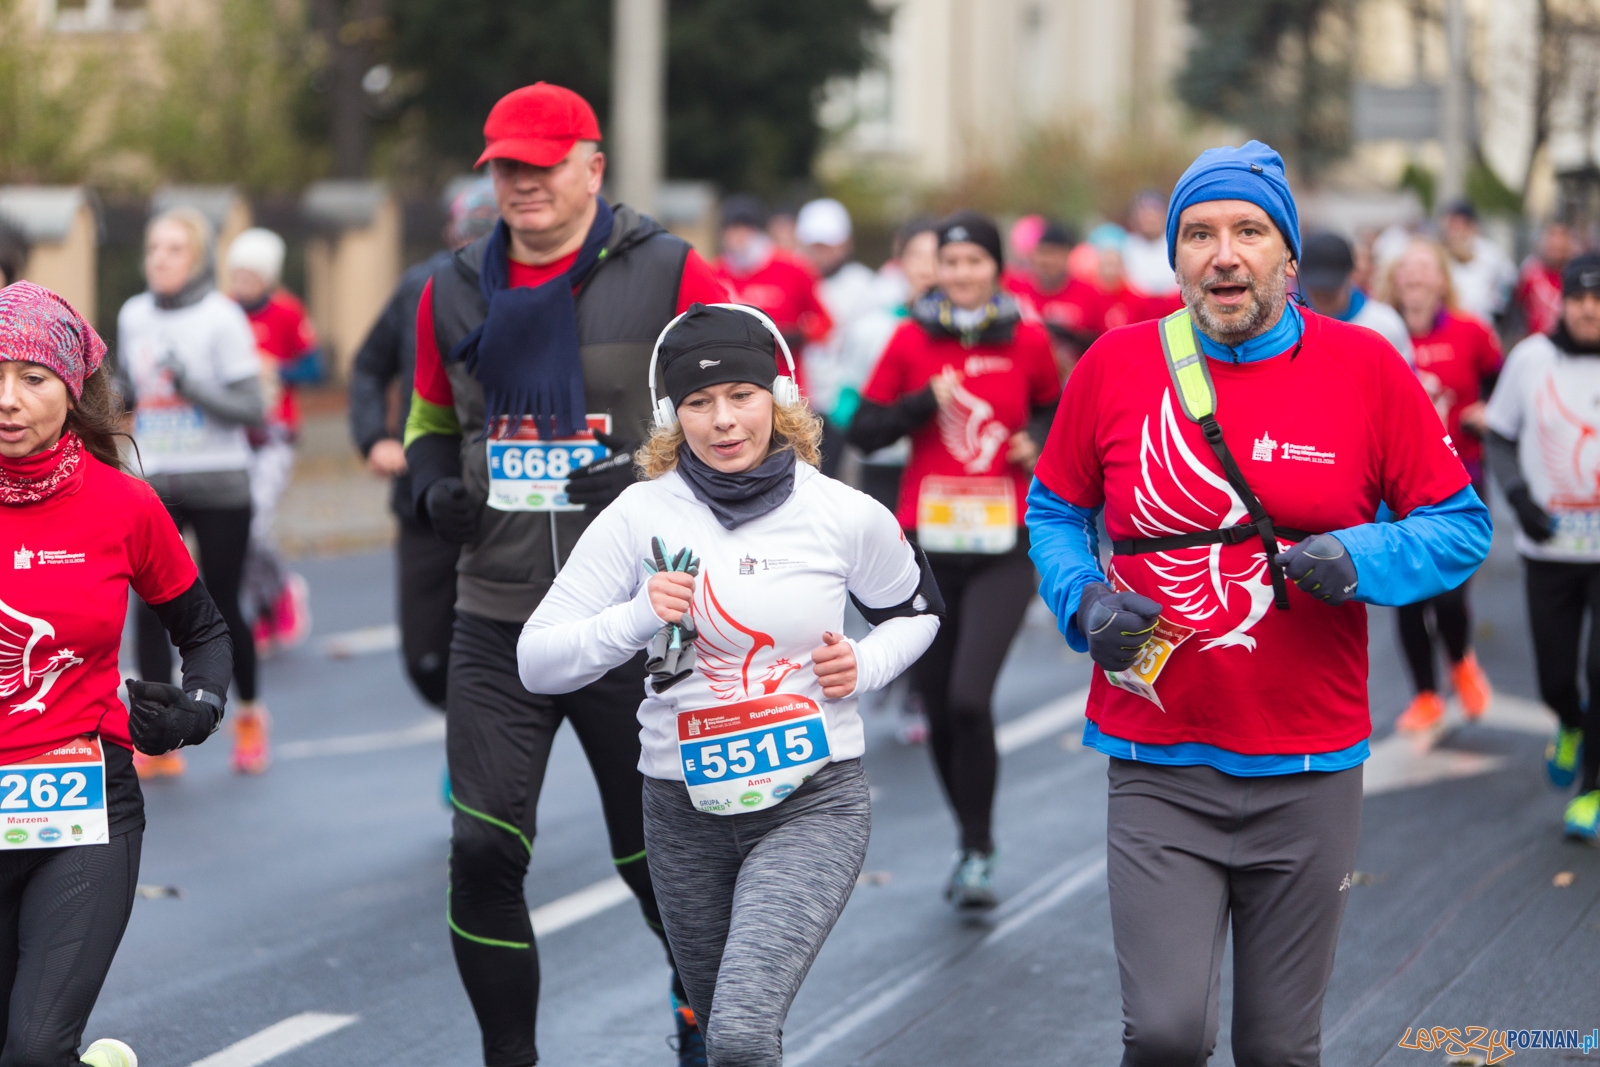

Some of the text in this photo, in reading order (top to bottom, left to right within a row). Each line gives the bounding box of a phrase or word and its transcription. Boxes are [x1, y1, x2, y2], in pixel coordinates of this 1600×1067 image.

[1281, 442, 1290, 459] 1
[37, 550, 46, 564] 1
[749, 701, 810, 720] RunPoland.org
[703, 718, 711, 730] 1
[685, 726, 813, 779] E 5515
[747, 776, 772, 787] Anna
[7, 816, 49, 824] Marzena
